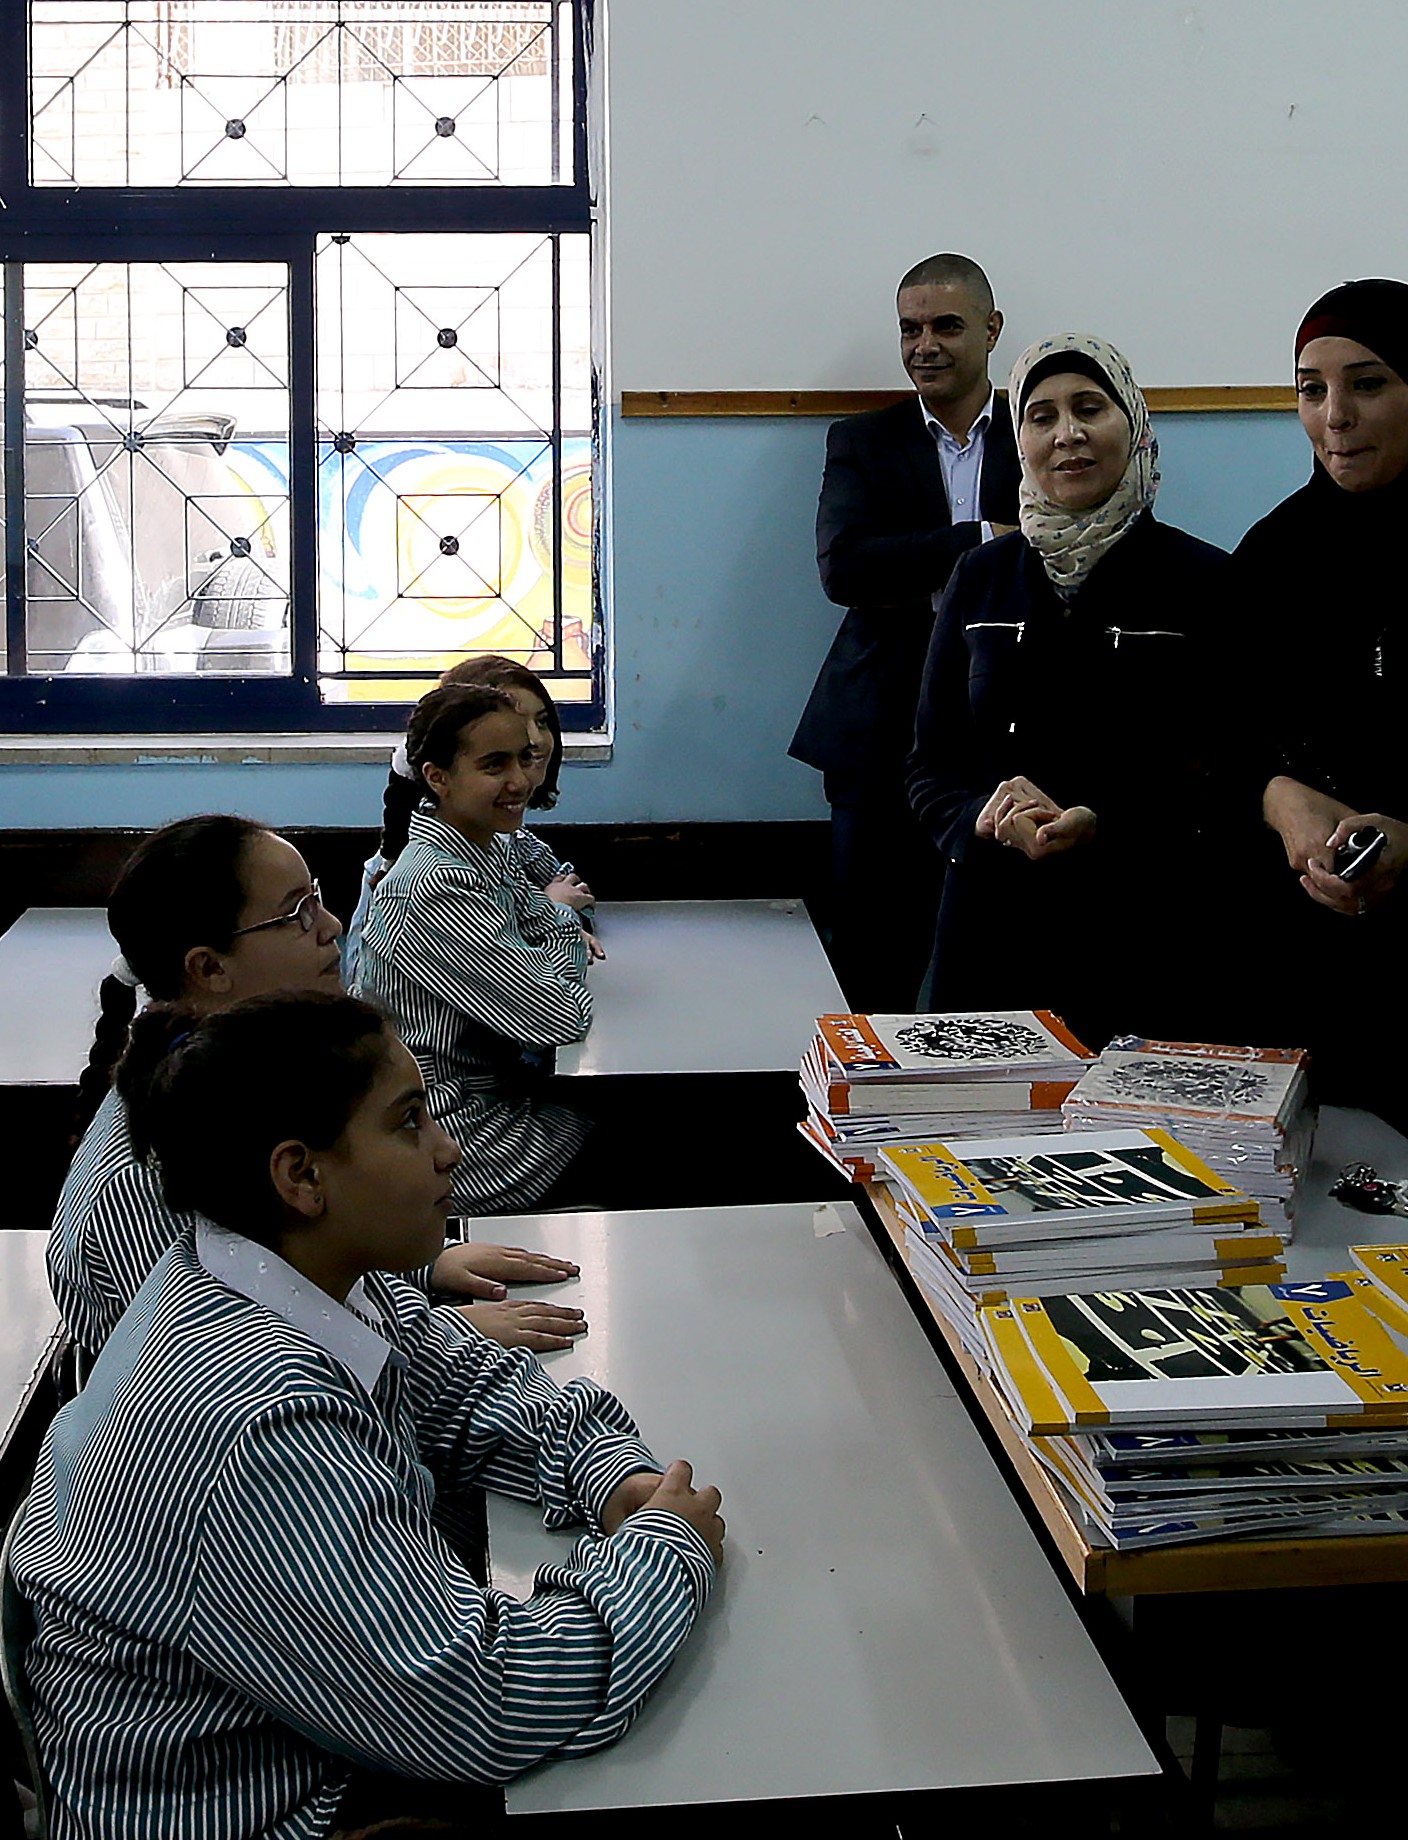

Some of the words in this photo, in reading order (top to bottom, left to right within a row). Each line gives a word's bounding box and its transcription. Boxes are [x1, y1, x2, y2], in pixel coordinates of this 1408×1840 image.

[919, 1156, 977, 1200] الرياضيات
[951, 1206, 985, 1216] ٧
[1291, 1284, 1328, 1297] ٧
[1302, 1306, 1383, 1377] الرياضيات
